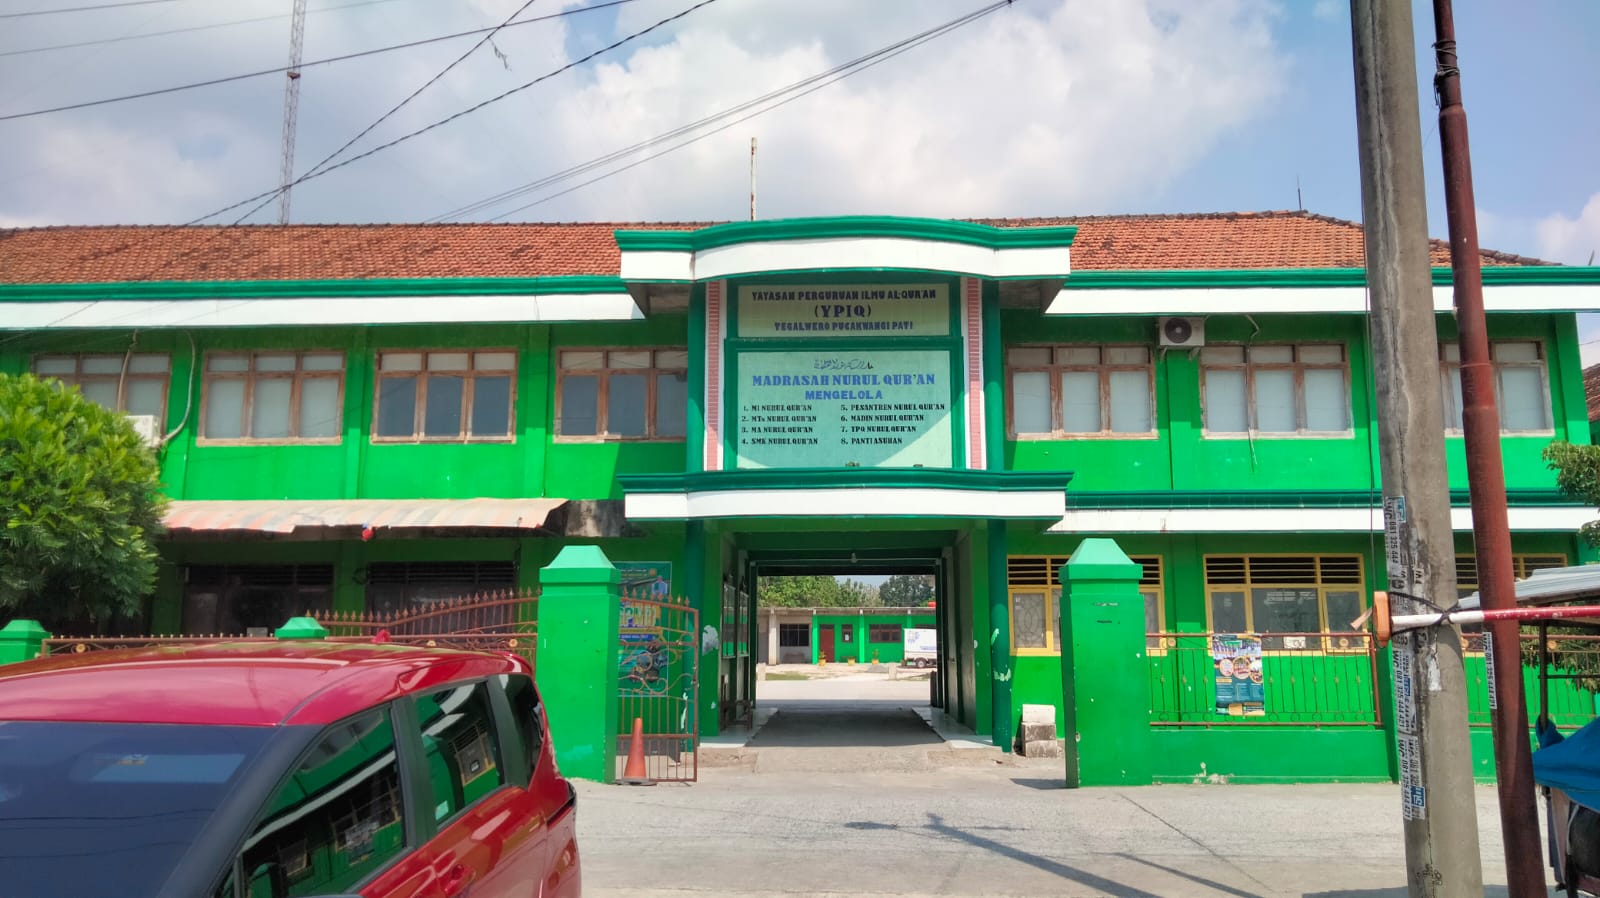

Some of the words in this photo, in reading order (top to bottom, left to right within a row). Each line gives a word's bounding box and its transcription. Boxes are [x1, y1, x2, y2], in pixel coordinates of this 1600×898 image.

[752, 290, 795, 301] YAYASAN
[797, 290, 859, 301] PERGURUAN
[861, 290, 885, 300] ILMU
[814, 304, 872, 318] (YPIQ)
[774, 321, 830, 331] TEGALWERO
[832, 321, 890, 331] PUCAKWANGI
[892, 321, 913, 330] PATI
[752, 374, 829, 386] MADRASAH
[832, 374, 880, 386] NURUL
[883, 373, 935, 386] QUR'AN
[805, 390, 883, 400] MENGELOLA
[918, 403, 945, 411] QUR'AN
[873, 437, 902, 445] ASUHAN
